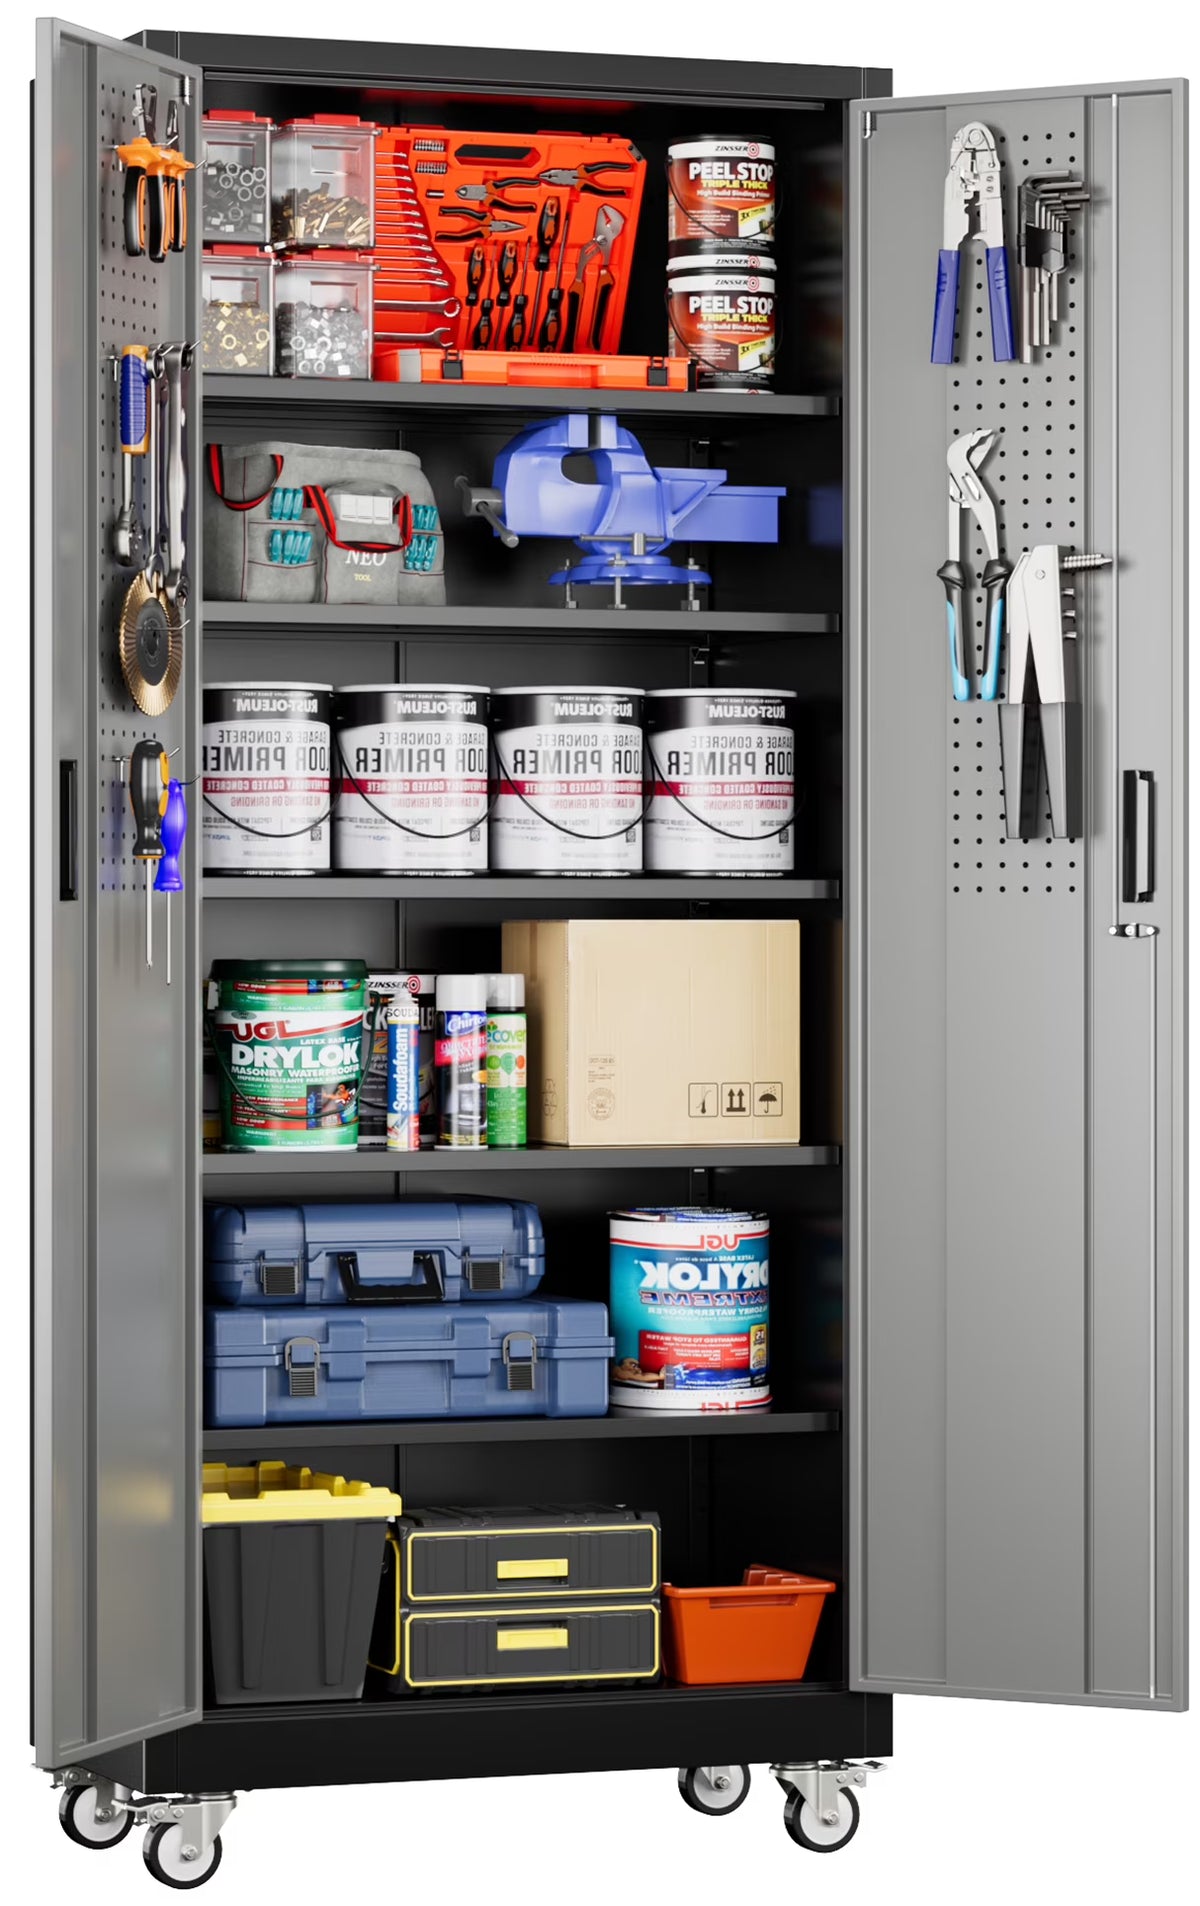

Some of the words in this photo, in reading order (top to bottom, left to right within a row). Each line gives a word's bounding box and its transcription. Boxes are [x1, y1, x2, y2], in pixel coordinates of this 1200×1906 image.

[689, 162, 736, 180] PEEL
[737, 162, 774, 181] STOP
[702, 180, 740, 188] TRIPLE
[742, 180, 768, 189] THICK
[689, 296, 736, 314] PEEL
[737, 296, 774, 315] STOP
[702, 314, 740, 322] TRIPLE
[742, 314, 768, 323] THICK
[345, 549, 387, 566] NEO
[354, 573, 372, 582] TOOL
[368, 981, 408, 989] ZINSSER
[232, 1042, 360, 1068] DRYLOK
[232, 1066, 284, 1077] MASONRY
[392, 1028, 409, 1112] Soudafoam
